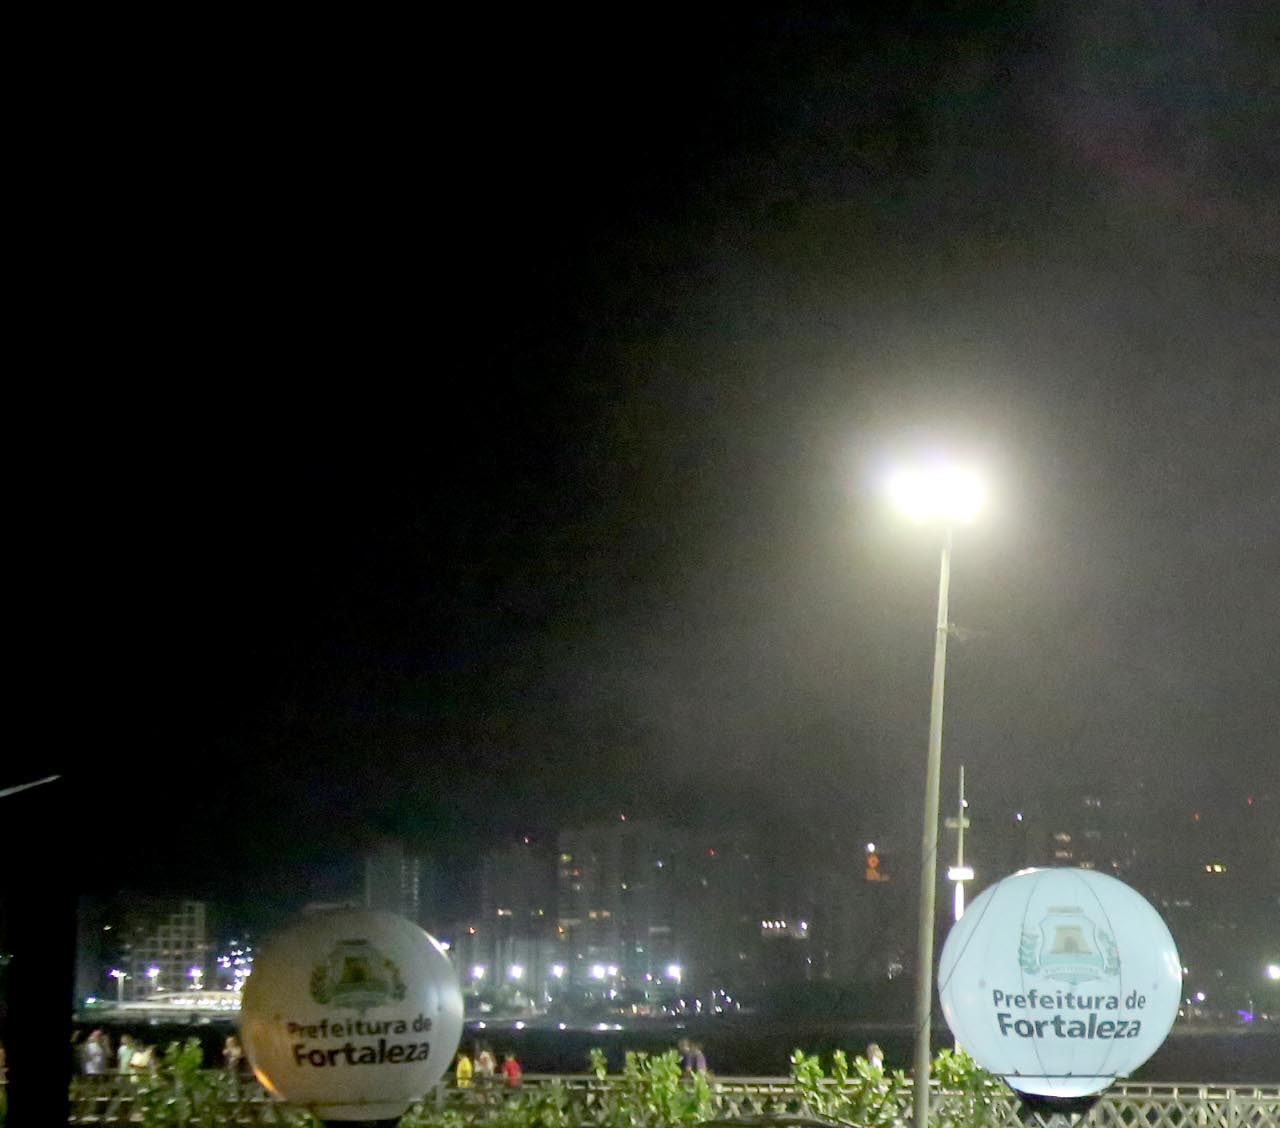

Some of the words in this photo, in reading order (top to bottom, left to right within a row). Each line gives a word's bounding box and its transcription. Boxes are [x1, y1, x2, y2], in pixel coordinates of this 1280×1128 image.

[993, 989, 1119, 1010] Prefeitura
[1125, 990, 1146, 1009] de
[287, 1019, 407, 1038] Prefeitura
[412, 1014, 432, 1032] de
[997, 1012, 1141, 1039] Fortaleza
[293, 1039, 430, 1067] Fortaleza
